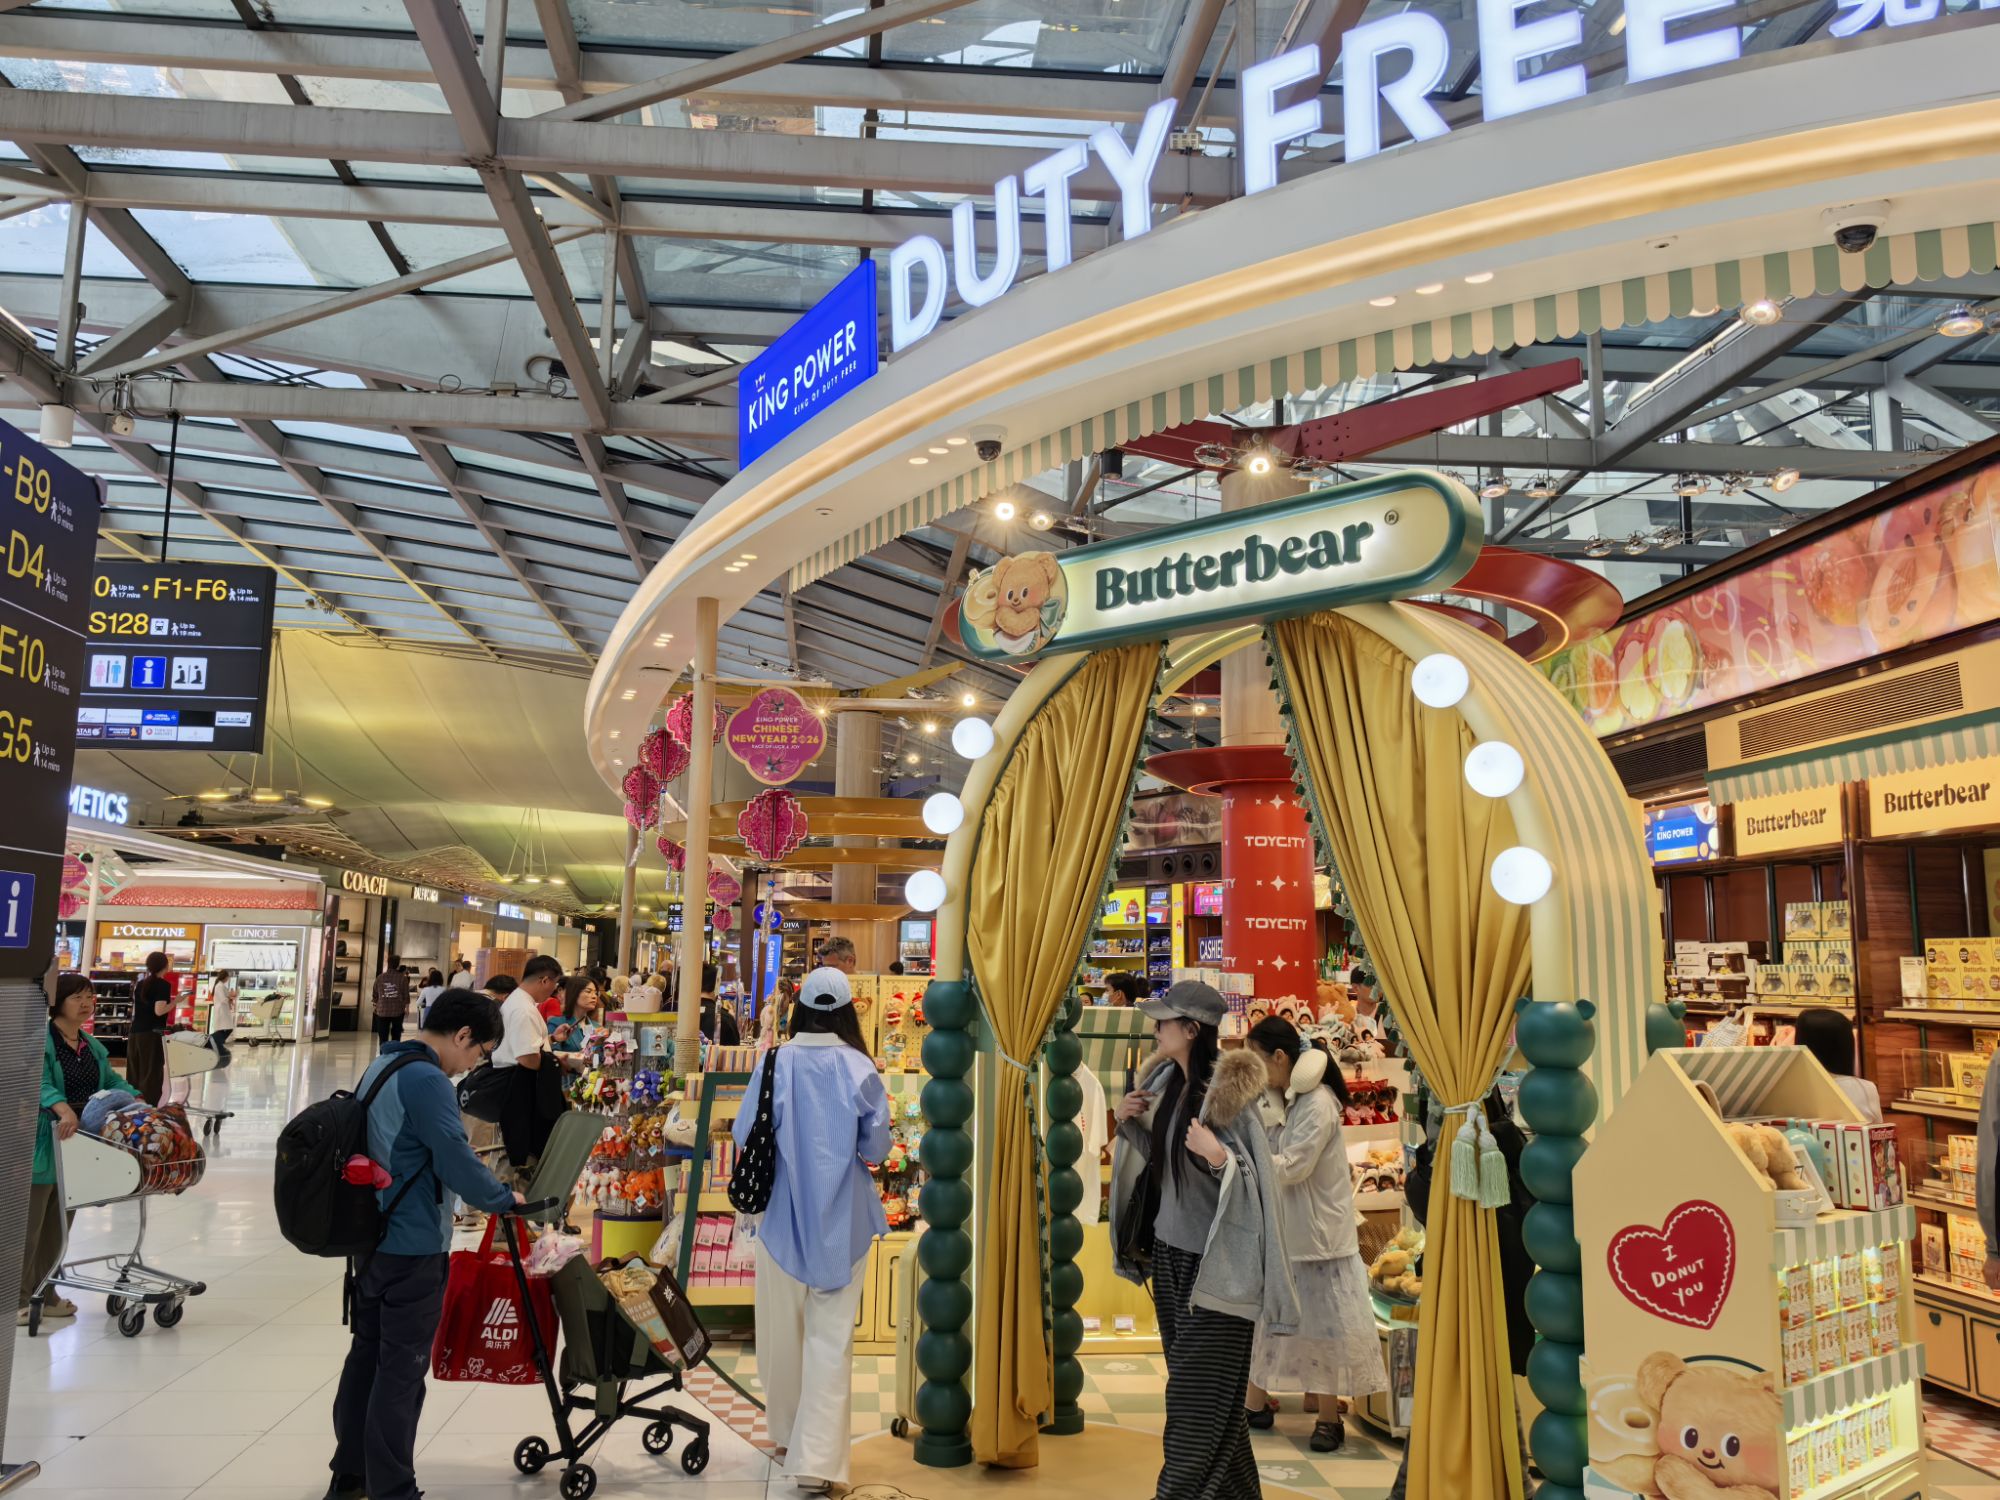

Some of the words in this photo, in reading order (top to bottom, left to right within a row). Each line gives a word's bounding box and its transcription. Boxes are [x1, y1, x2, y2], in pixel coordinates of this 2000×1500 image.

[890, 97, 1178, 352] DUTY
[748, 377, 789, 433] KING
[794, 320, 857, 399] POWER
[793, 398, 809, 416] KING
[822, 374, 838, 393] DUTY
[841, 359, 857, 380] FREE
[0, 442, 51, 514] -B9
[58, 501, 66, 513] Up
[1095, 519, 1375, 613] Butterbear
[53, 572, 61, 586] Up
[118, 584, 128, 592] Up
[88, 611, 149, 635] S128
[179, 622, 189, 630] Up
[52, 666, 60, 680] Up
[752, 724, 801, 733] CHINESE
[732, 734, 757, 743] NEW
[760, 735, 788, 743] YEAR
[791, 735, 819, 744] 2026
[42, 743, 50, 756] Up
[1883, 780, 1991, 815] Butterbear
[1746, 807, 1827, 836] Butterbear
[1656, 831, 1672, 840] KING
[1672, 826, 1694, 838] POWER
[342, 870, 389, 896] COACH
[232, 929, 279, 939] CLINIQUE
[761, 1113, 767, 1121] 9
[1661, 1244, 1678, 1263] I
[1651, 1258, 1704, 1289] DONUT
[480, 1326, 519, 1341] ALDI
